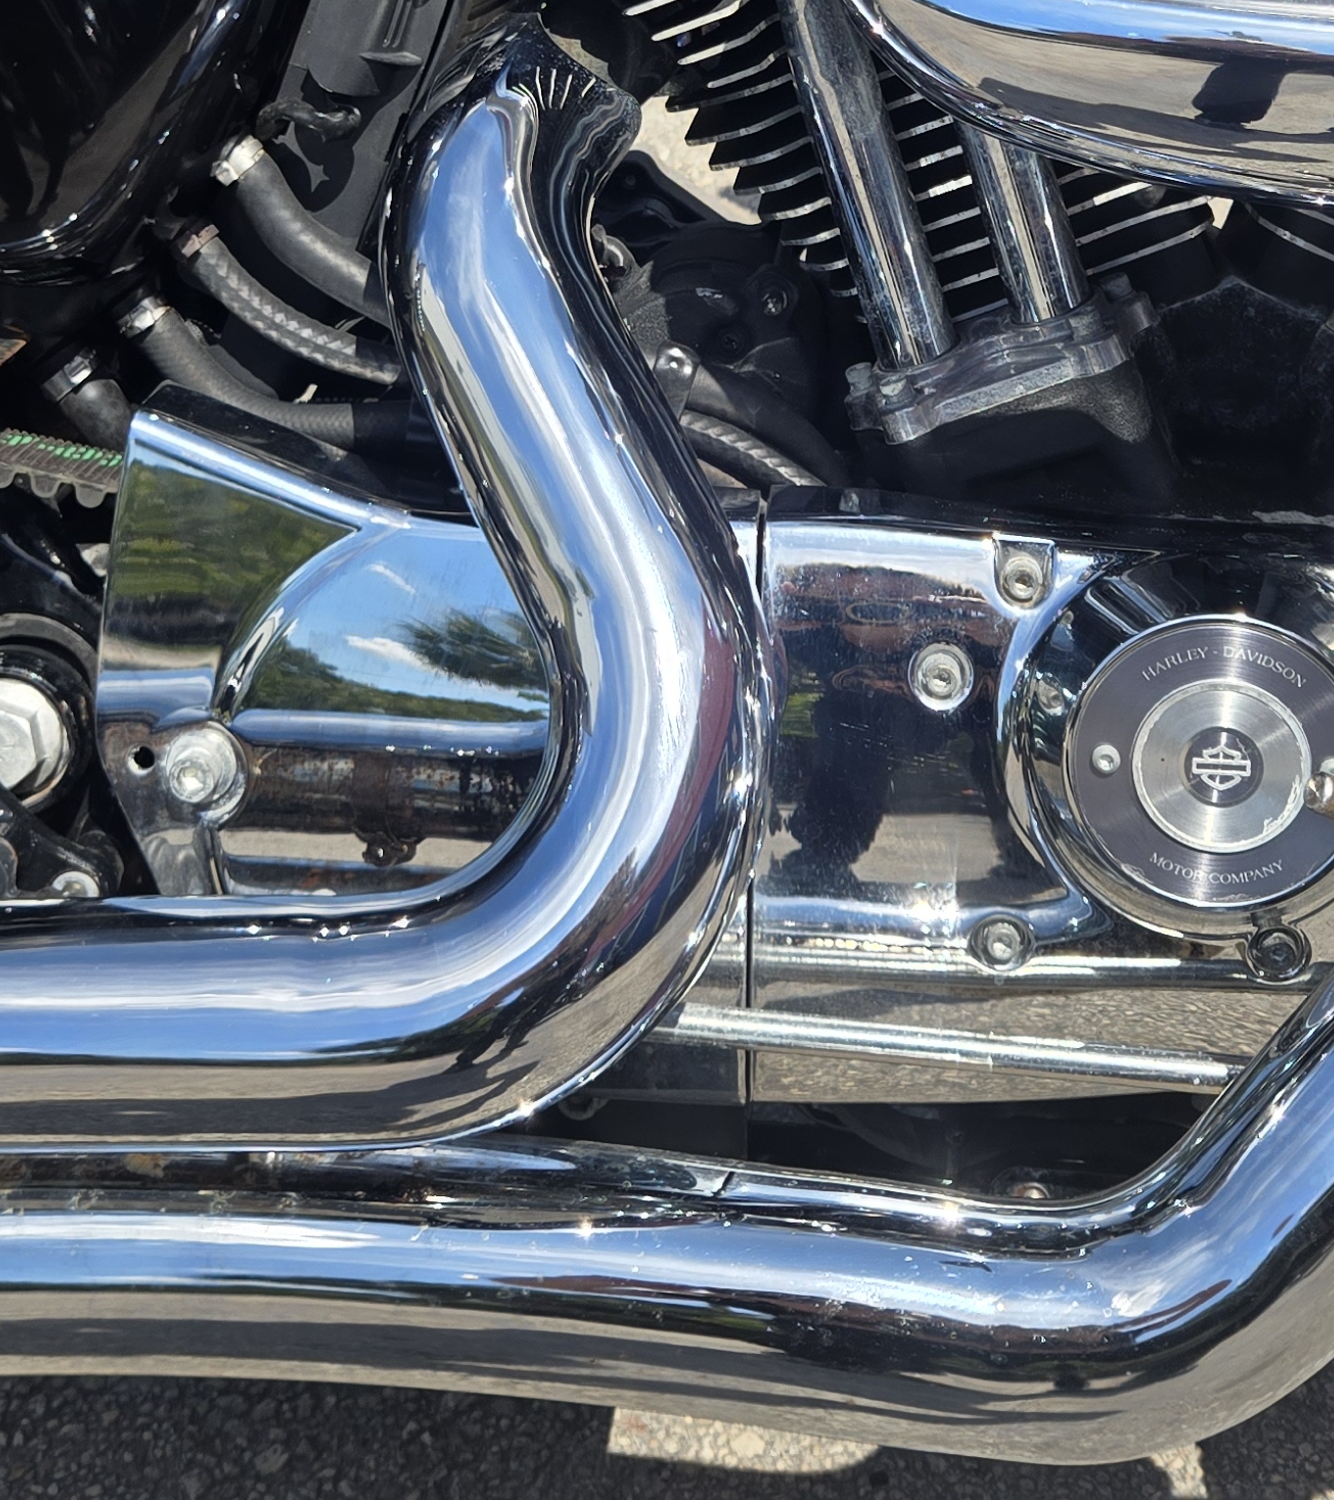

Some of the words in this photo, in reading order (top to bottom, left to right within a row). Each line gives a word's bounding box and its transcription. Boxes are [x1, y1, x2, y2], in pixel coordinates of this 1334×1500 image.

[1141, 646, 1208, 681] HARLEY
[1223, 646, 1307, 688] DAVIDSON
[1149, 852, 1205, 880] MOTOR
[1208, 859, 1284, 884] COMPANY
